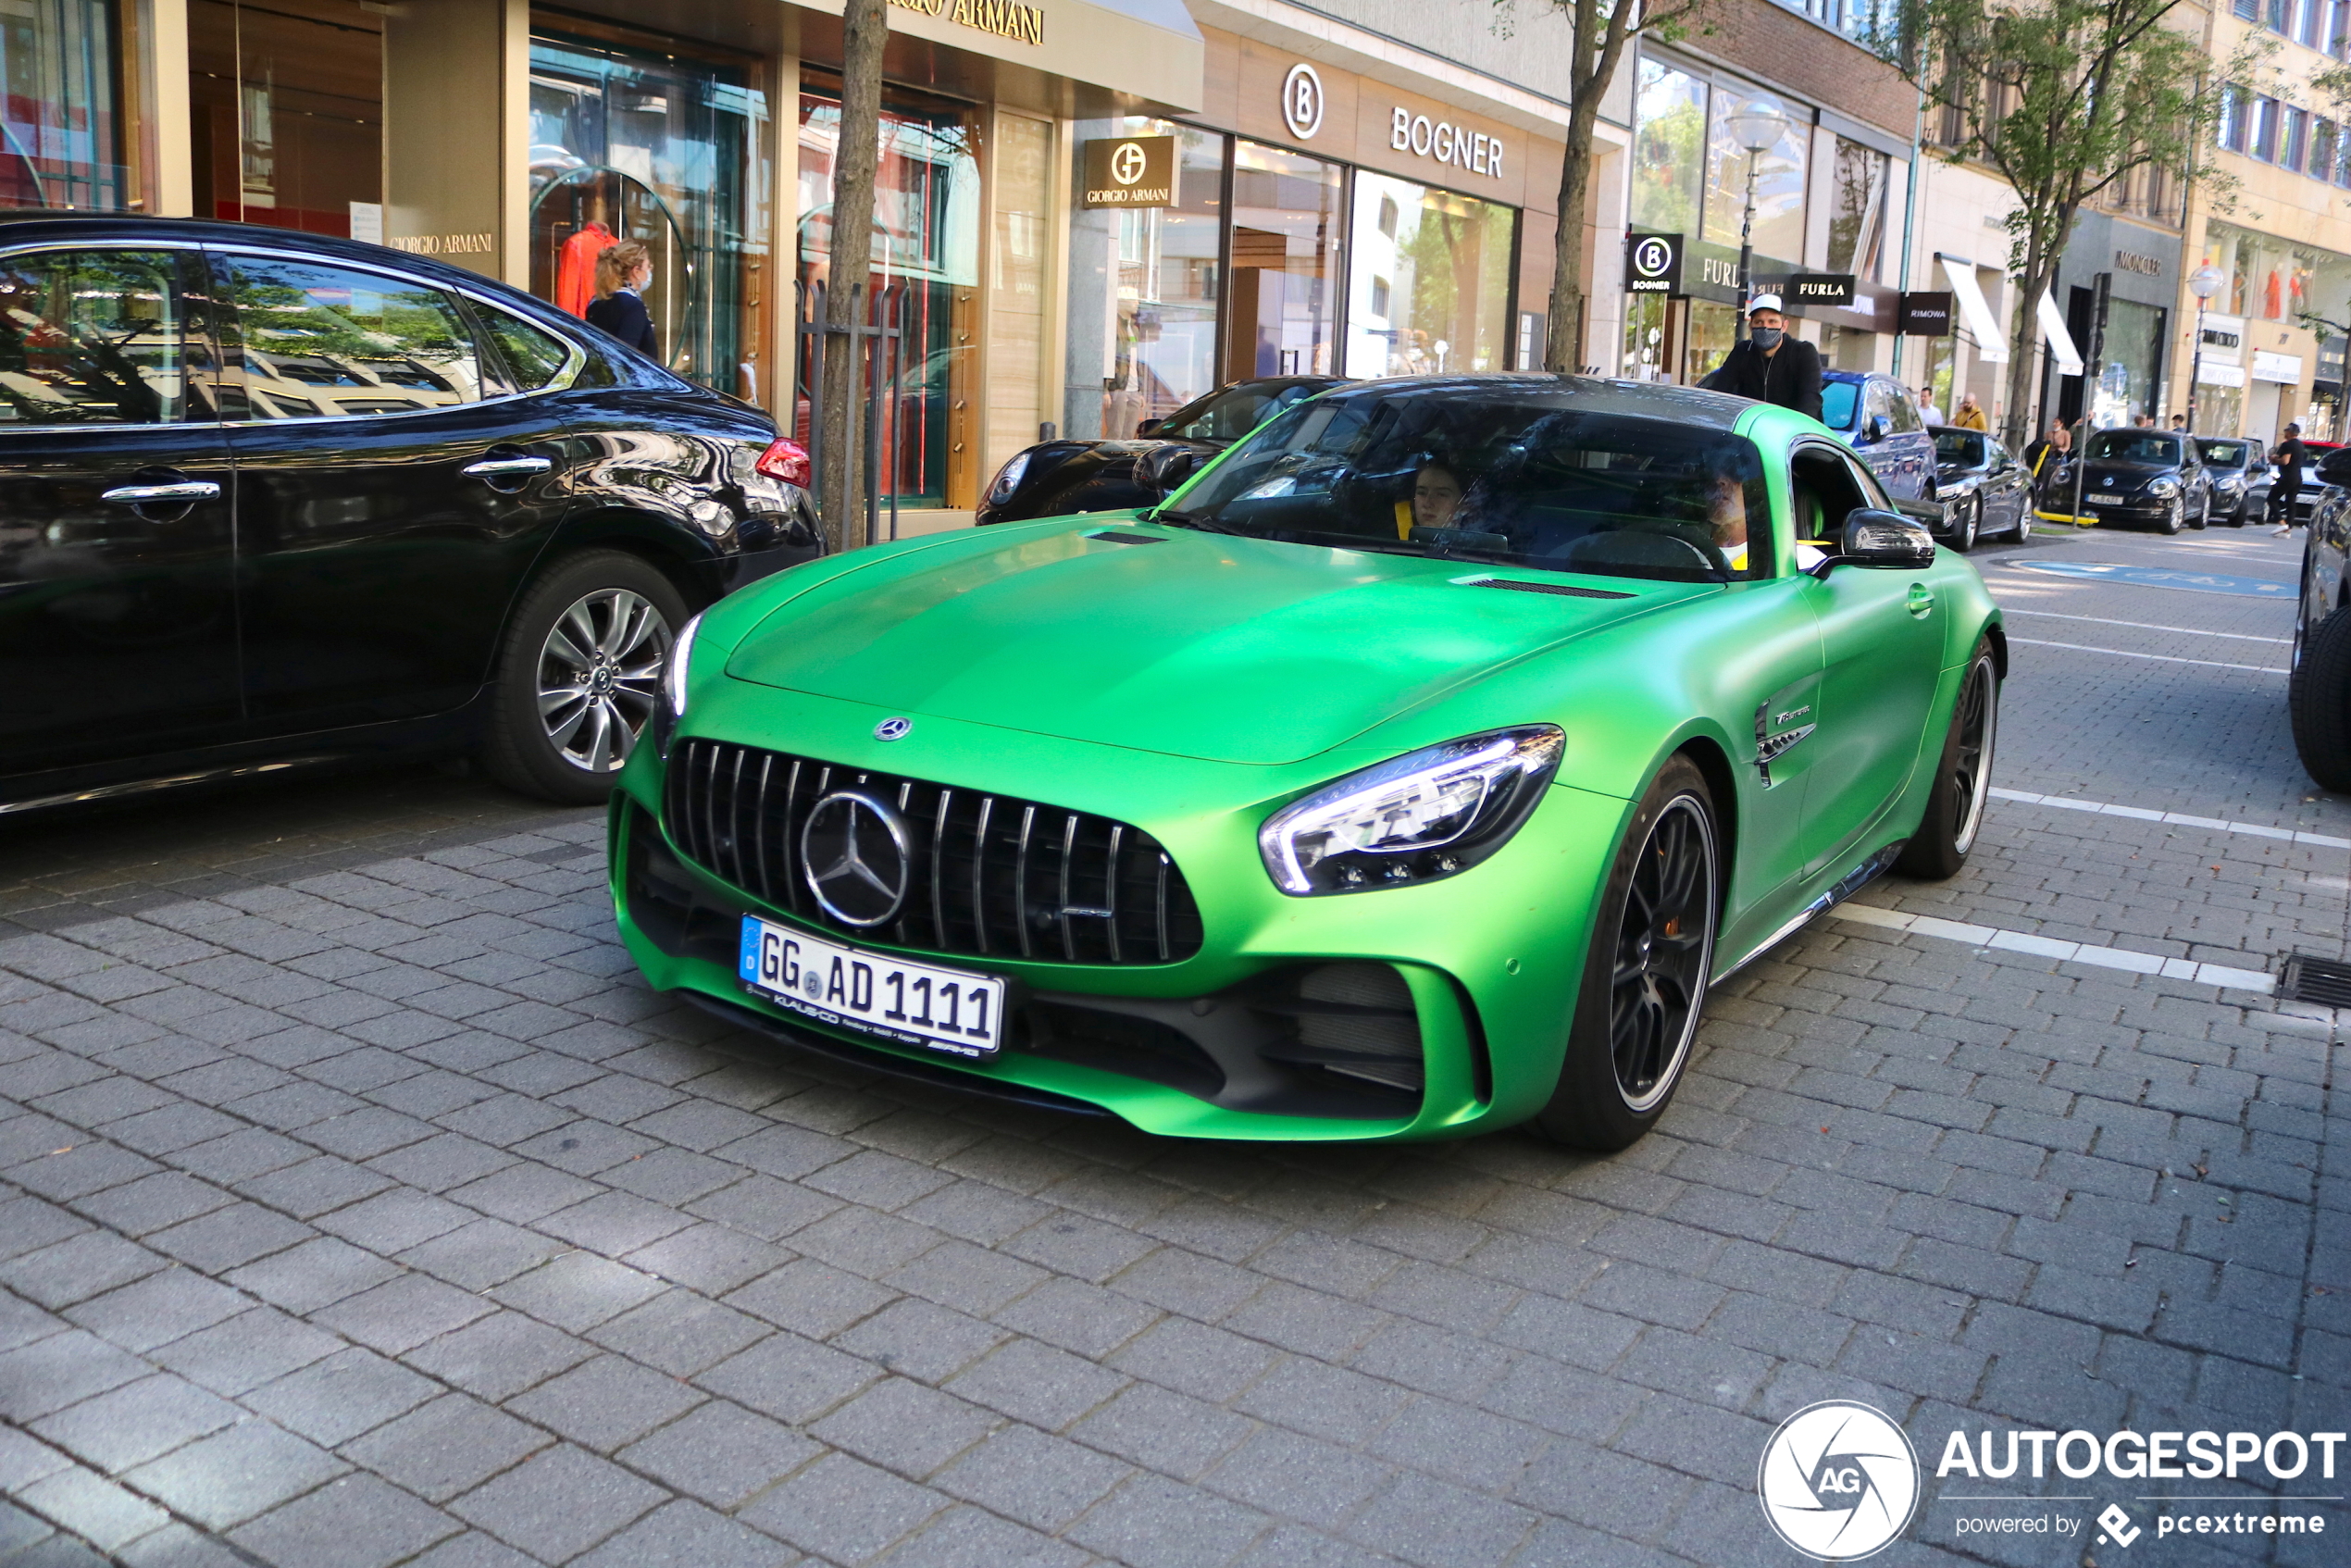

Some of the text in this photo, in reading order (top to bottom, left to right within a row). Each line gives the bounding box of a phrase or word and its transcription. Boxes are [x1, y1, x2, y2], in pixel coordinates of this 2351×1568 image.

[951, 0, 1044, 45] ARMANI
[1392, 106, 1503, 179] BOGNER
[1087, 188, 1169, 203] GIORGIO ARMANI
[390, 233, 491, 255] GIORGIO ARMANI
[1703, 258, 1740, 289] FURL
[1633, 280, 1670, 291] BOGNER
[1798, 282, 1845, 296] FURLA
[1910, 309, 1946, 319] RIMOWA
[762, 932, 991, 1039] GG AD 1111
